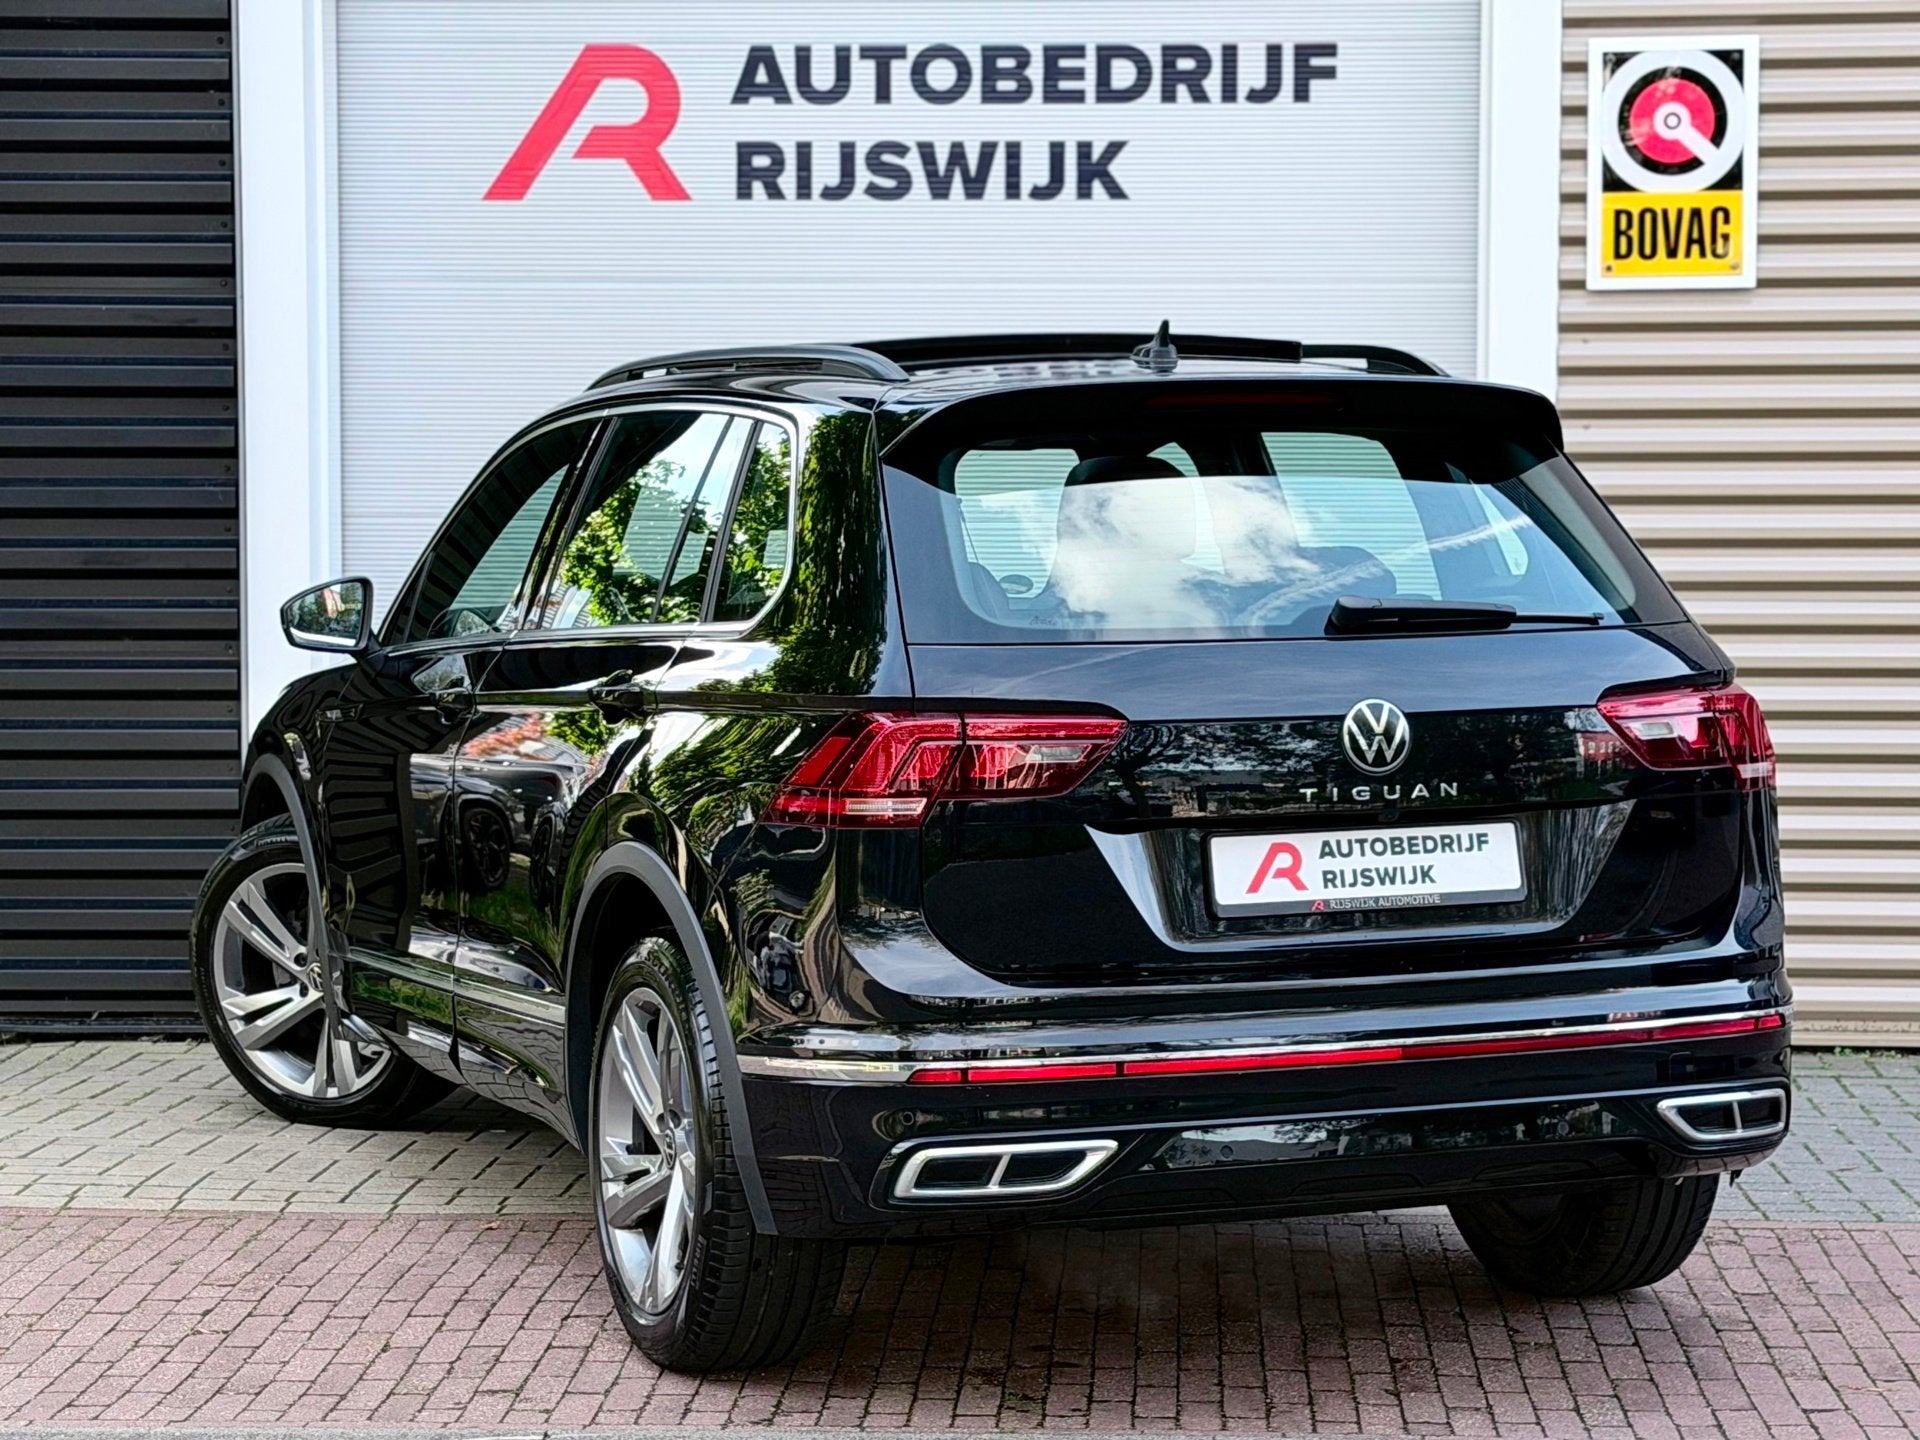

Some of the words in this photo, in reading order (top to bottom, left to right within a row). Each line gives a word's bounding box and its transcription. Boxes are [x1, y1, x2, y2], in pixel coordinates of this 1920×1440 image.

[731, 43, 1338, 105] AUTOBEDRIJF
[735, 140, 1129, 200] RIJSWIJK
[1613, 206, 1731, 261] BOVAG
[1299, 782, 1458, 803] TIGUAN
[1318, 832, 1490, 860] AUTOBEDRIJF
[1321, 864, 1437, 889] RIJSWIJK
[1329, 898, 1376, 909] RIJSWIJK
[1378, 894, 1441, 906] AUTOMOTIVE
